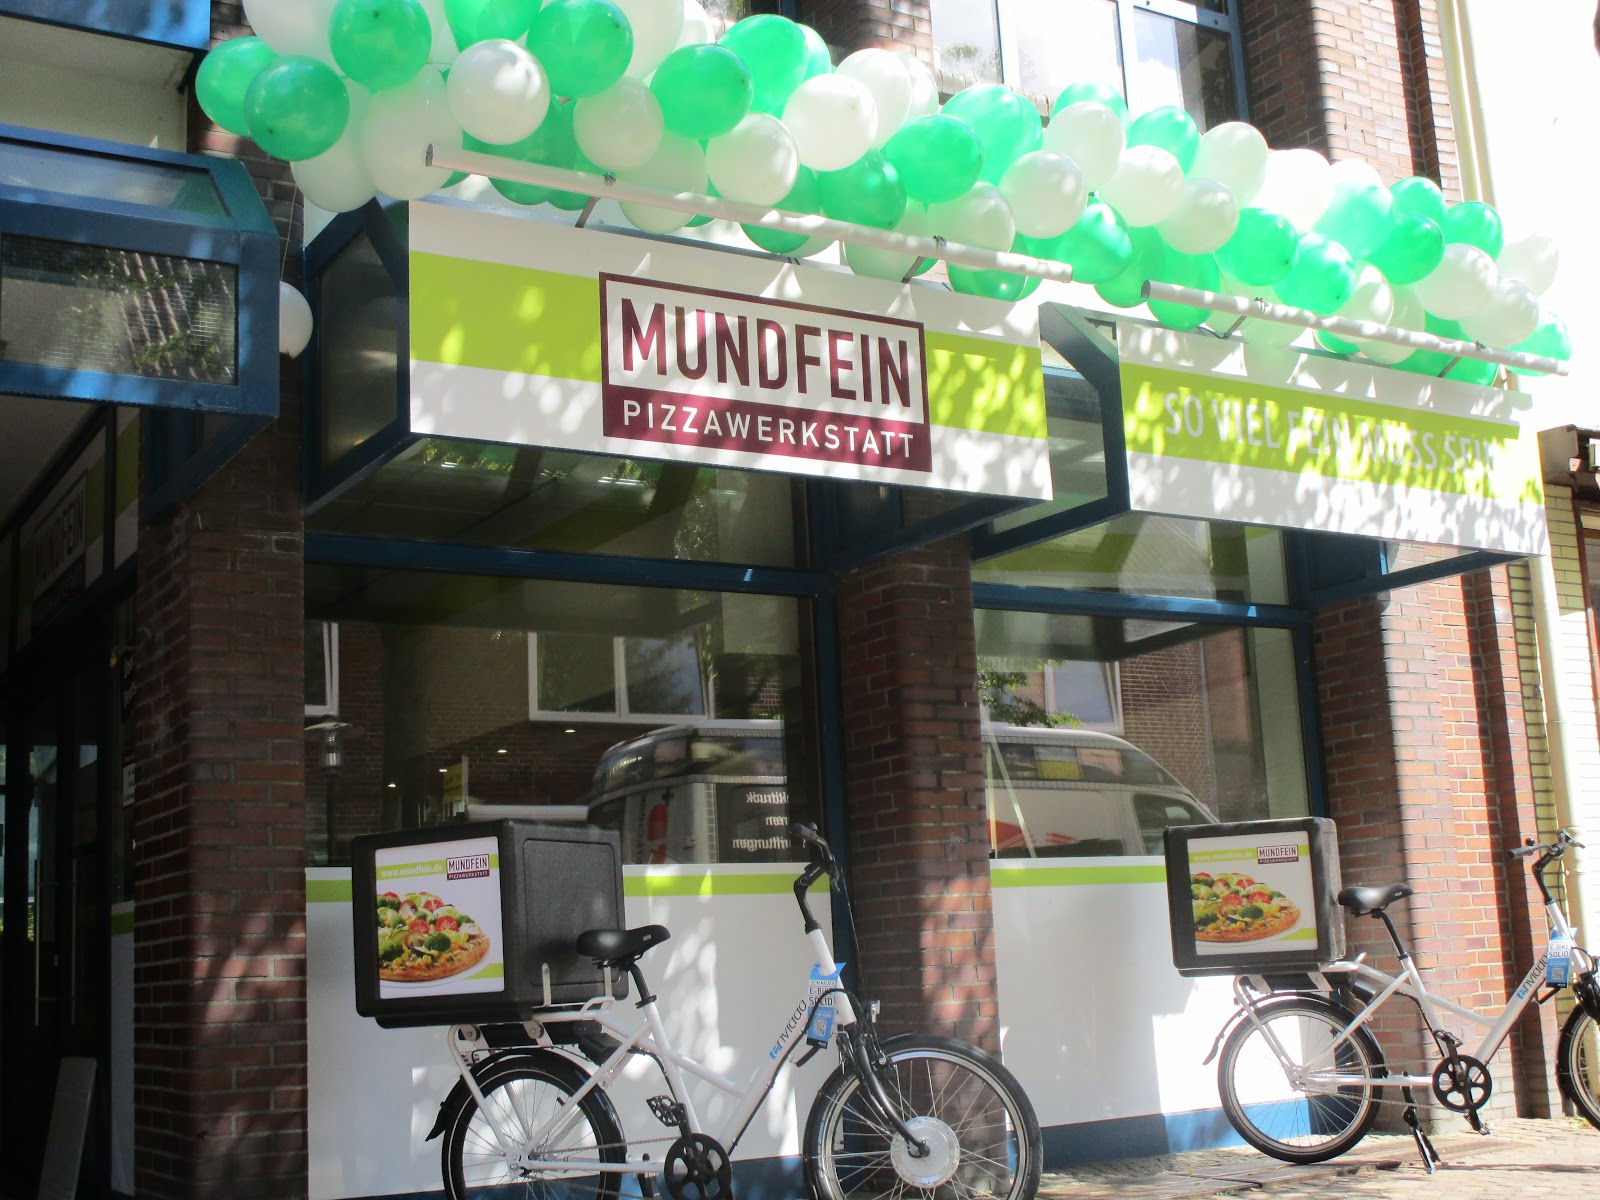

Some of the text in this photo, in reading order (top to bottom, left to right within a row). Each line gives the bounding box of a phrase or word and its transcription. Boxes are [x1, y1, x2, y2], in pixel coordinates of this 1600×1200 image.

[621, 298, 911, 408] MUNDFEIN
[623, 399, 914, 458] PIZZAWERKSTATT
[1164, 391, 1203, 439] SO
[1211, 398, 1280, 449] VIEL
[1287, 411, 1352, 458] FEIN
[449, 857, 488, 870] MUNDFEIN
[1259, 847, 1297, 857] MUNDFEIN
[382, 865, 442, 877] www.mundfein.de
